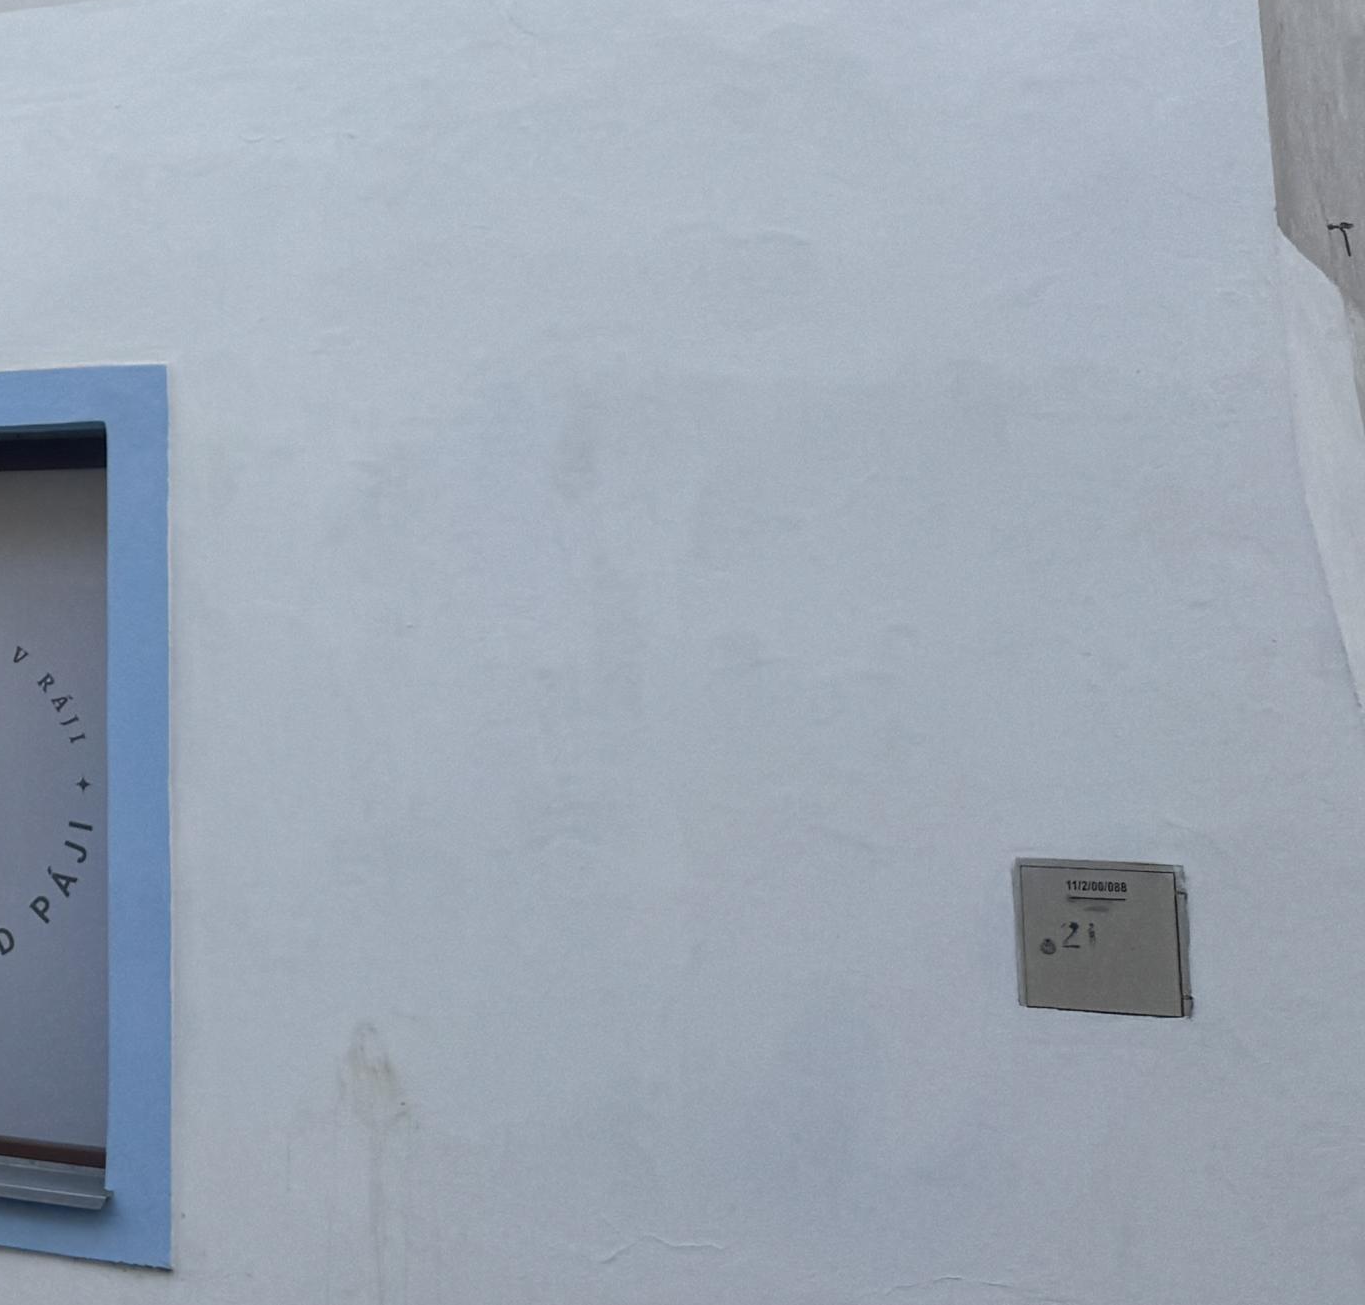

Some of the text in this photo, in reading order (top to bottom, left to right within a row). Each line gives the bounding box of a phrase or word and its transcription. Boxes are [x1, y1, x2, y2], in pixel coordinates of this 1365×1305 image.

[12, 646, 29, 664] V
[37, 672, 86, 744] RÁJI
[29, 820, 93, 924] PÁJI
